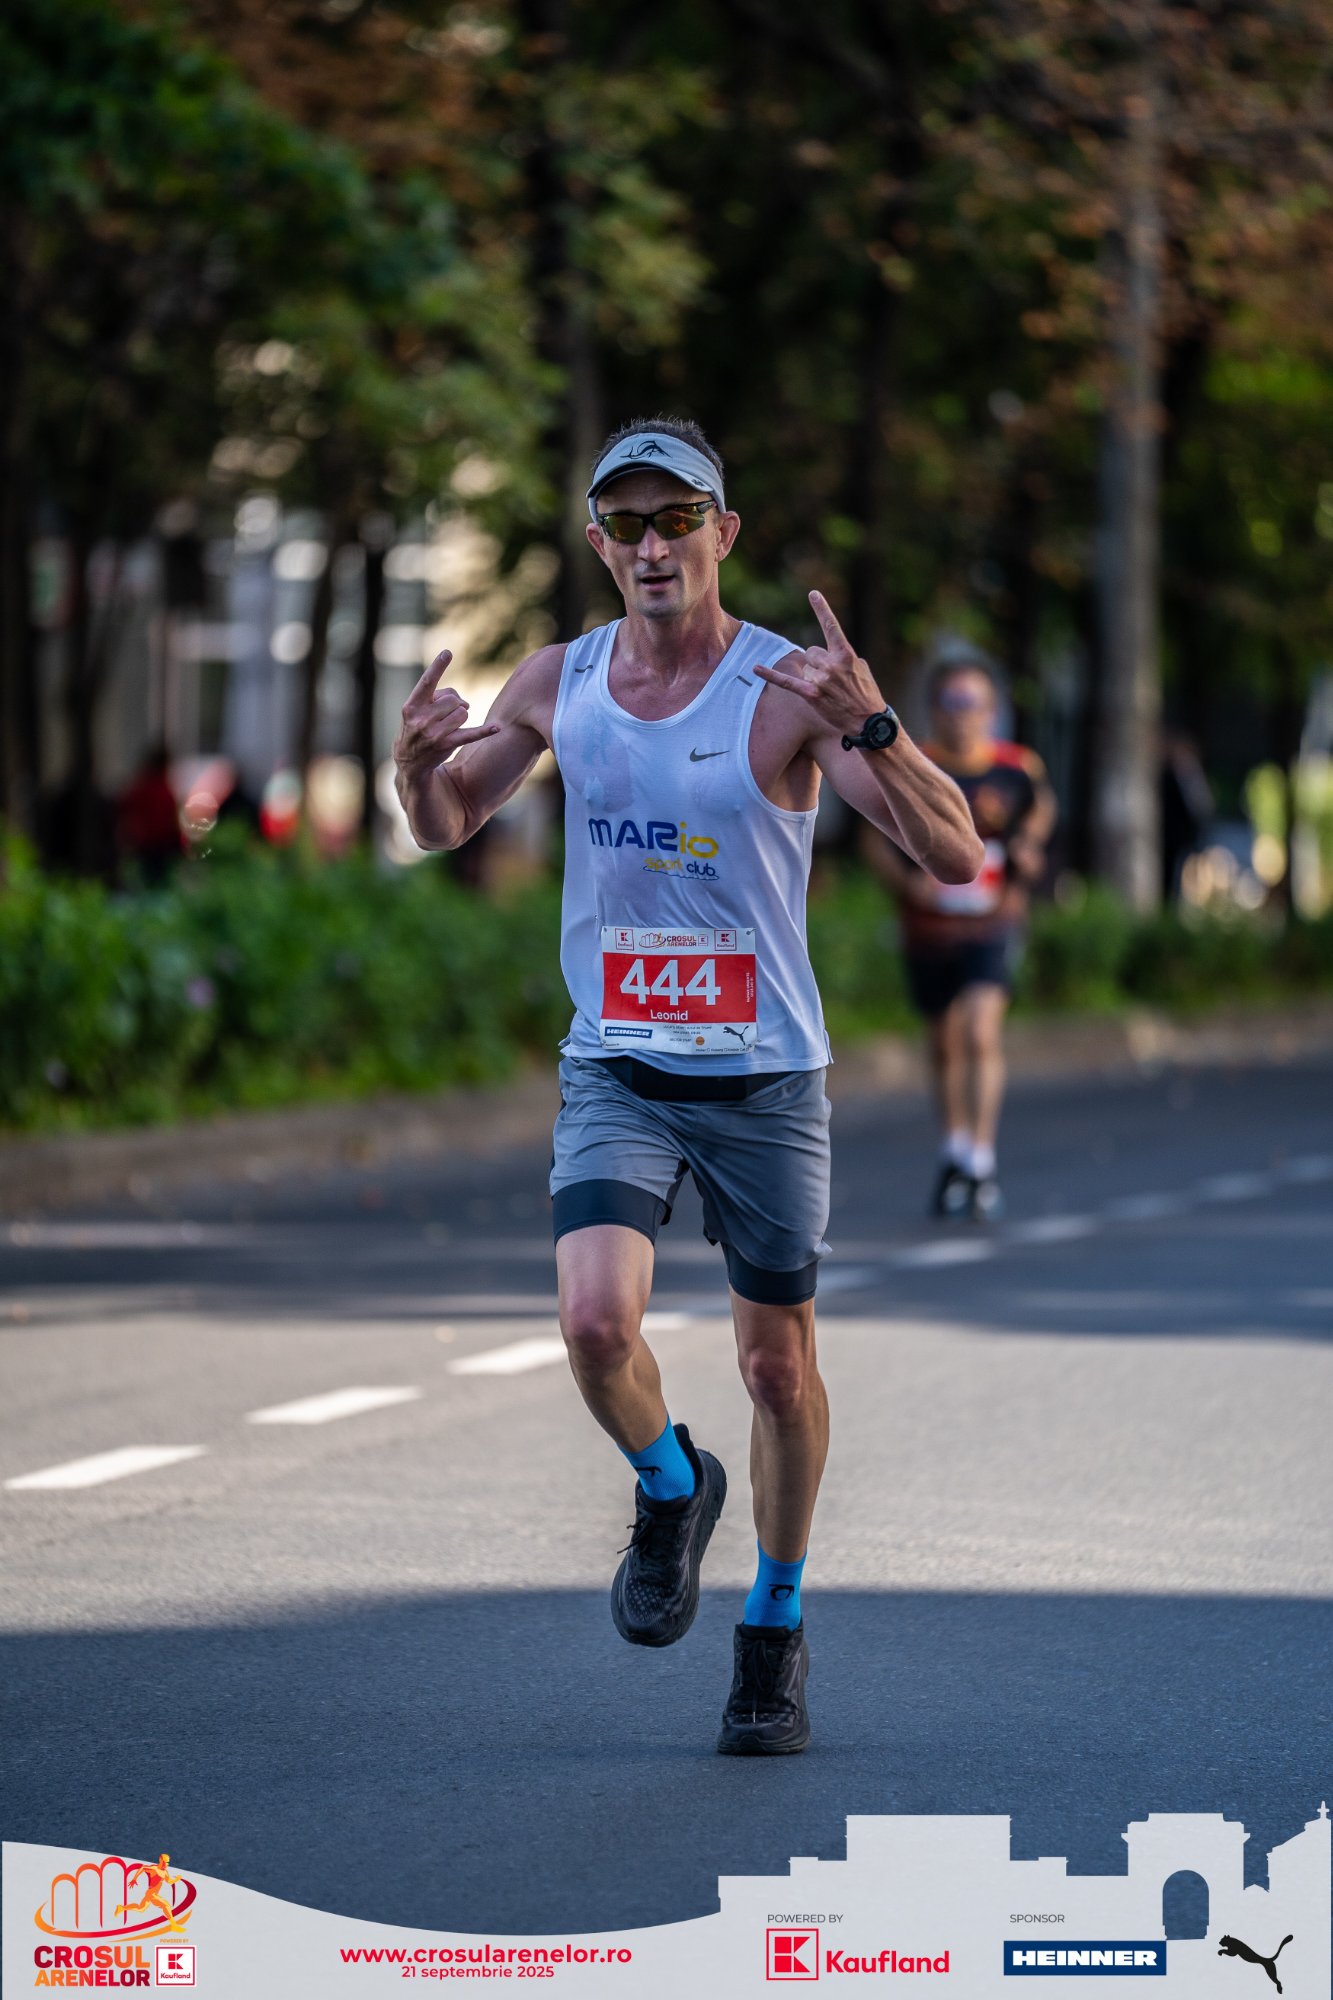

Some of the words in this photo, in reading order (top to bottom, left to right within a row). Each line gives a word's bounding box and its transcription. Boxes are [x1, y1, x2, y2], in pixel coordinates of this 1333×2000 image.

[646, 858, 683, 871] sport
[686, 863, 717, 876] club
[666, 935, 697, 943] CROSUL
[619, 958, 722, 1006] 444
[650, 1009, 689, 1021] Leonid
[606, 1028, 650, 1036] HEINNER
